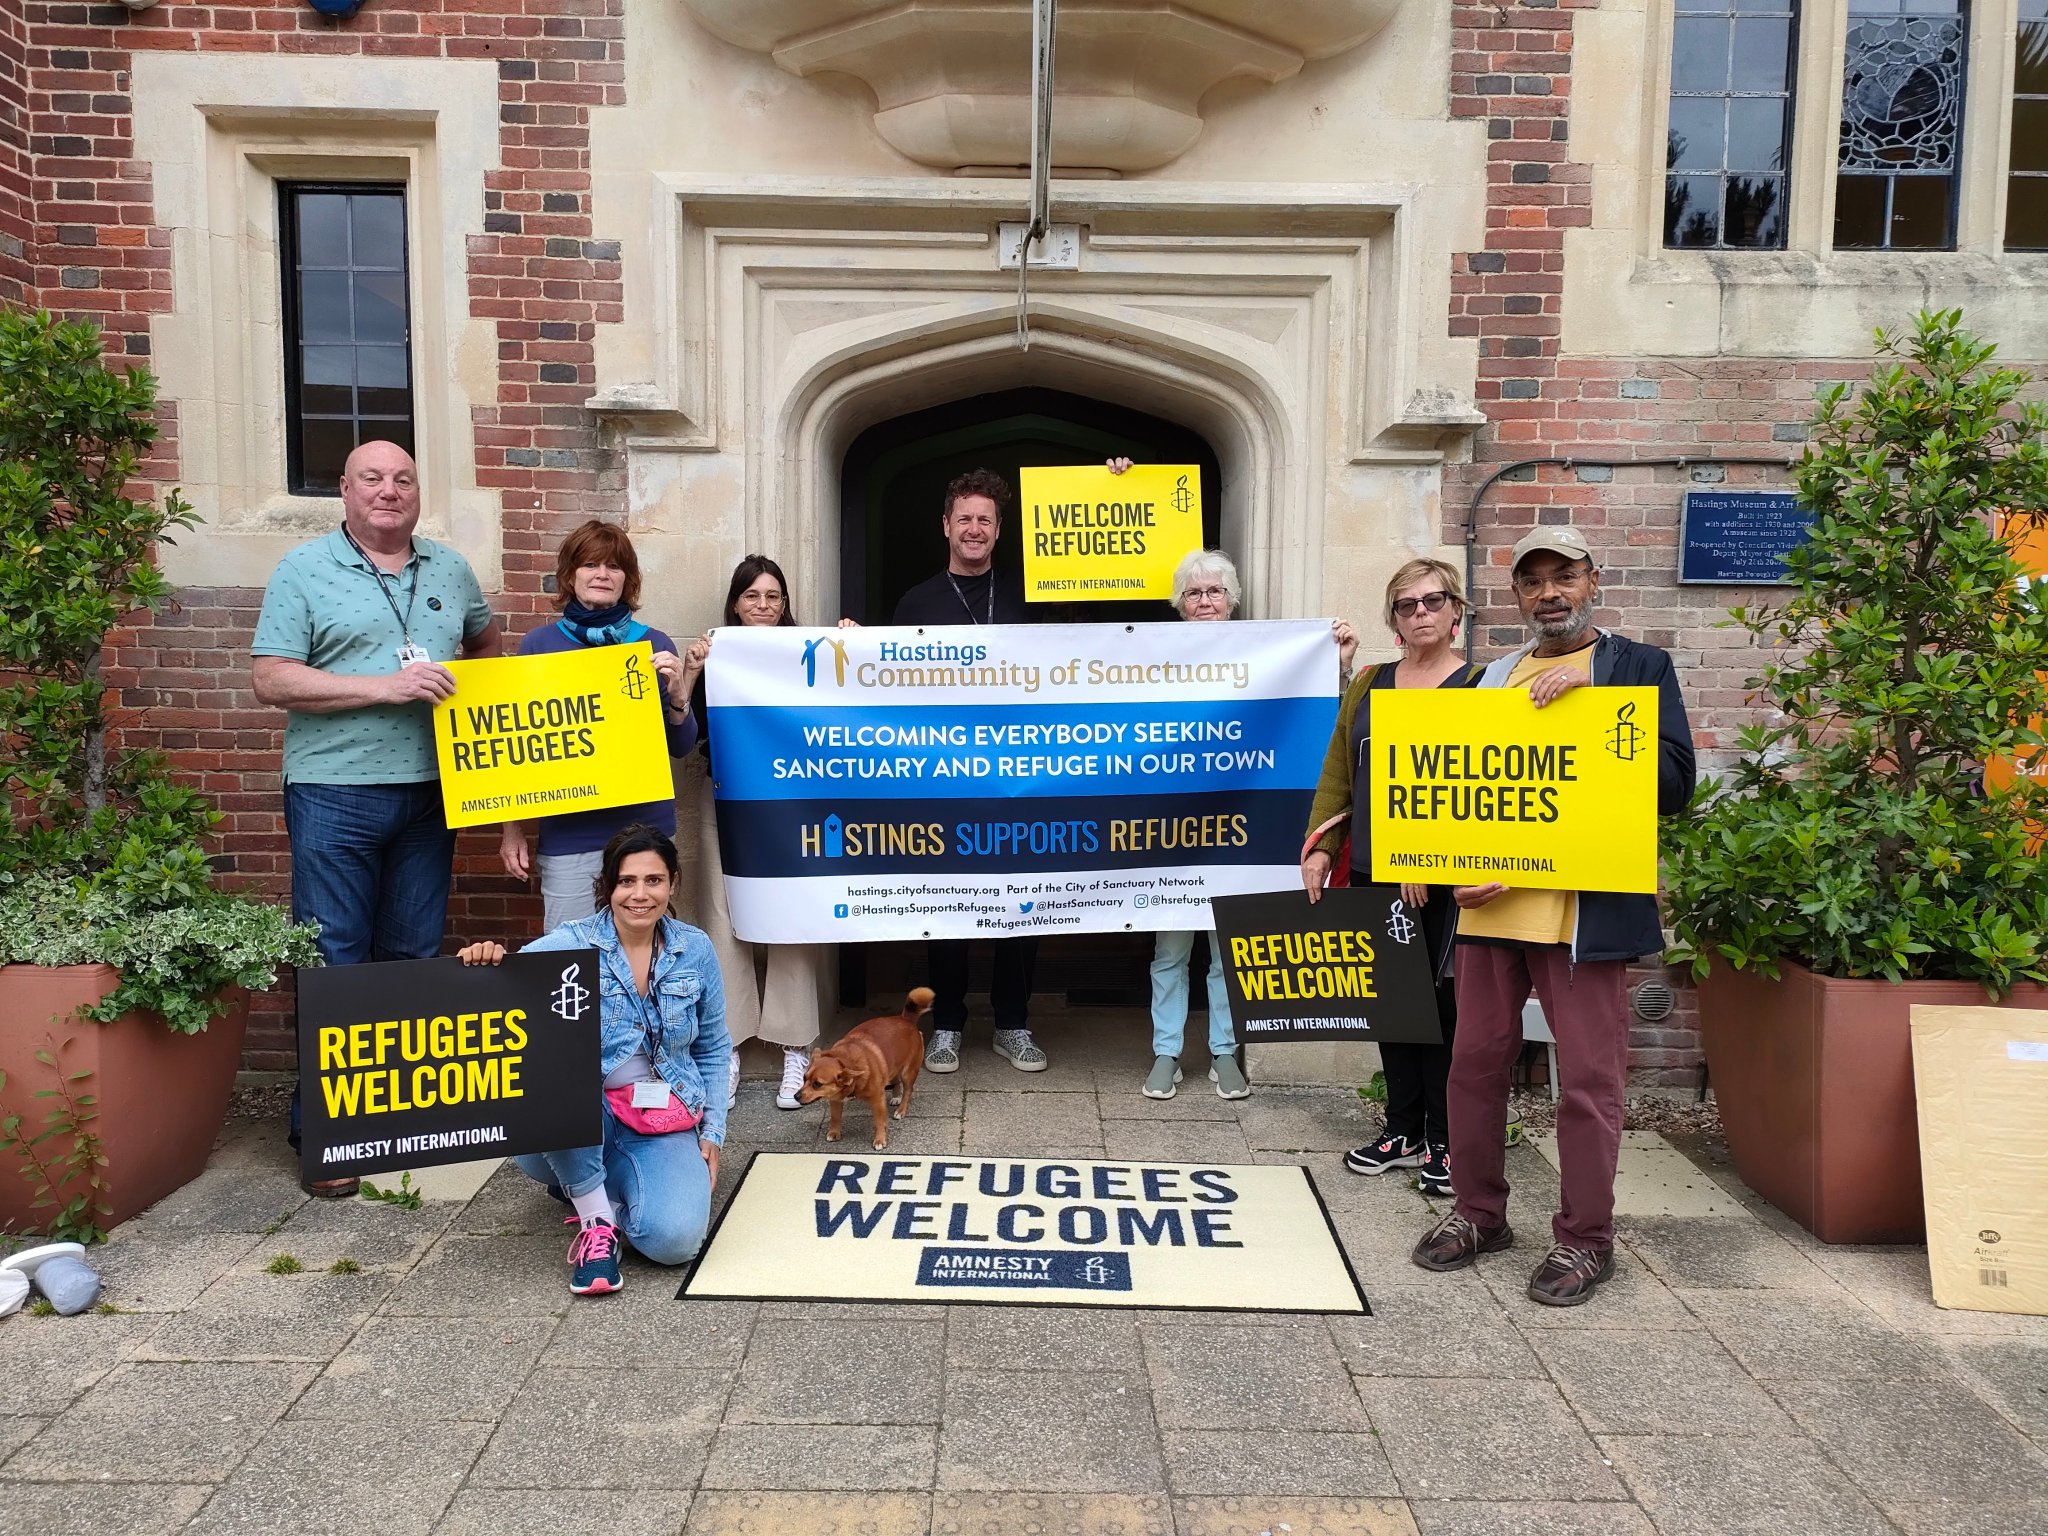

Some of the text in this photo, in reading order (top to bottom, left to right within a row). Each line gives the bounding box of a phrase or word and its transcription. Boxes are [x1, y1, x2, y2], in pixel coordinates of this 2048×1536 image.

[1034, 503, 1156, 529] I WELCOME
[1691, 500, 1728, 510] Hastings
[1730, 500, 1767, 508] Museum
[1769, 500, 1777, 508] &
[1035, 530, 1146, 557] REFUGEES
[1690, 541, 1726, 549] Re-opened
[1728, 542, 1736, 550] by
[1712, 550, 1737, 558] Deputy
[1740, 550, 1762, 558] Mayor
[1717, 570, 1744, 578] Hastings
[1732, 558, 1747, 566] July
[1037, 578, 1146, 591] AMNESTY INTERNATIONAL
[879, 640, 987, 666] Hastings
[857, 658, 1249, 693] Community of Sanctuary
[449, 693, 605, 738] I WELCOME
[802, 720, 1242, 747] WELCOMING EVERYBODY SEEKING
[452, 728, 595, 772] REFUGEES
[1388, 744, 1578, 782] I WELCOME
[772, 750, 1274, 779] SANCTUARY AND REFUGE IN OUR TOWN
[461, 784, 600, 813] AMNESTY INTERNATIONAL
[1388, 784, 1559, 824] REFUGEES
[801, 813, 1248, 858] HSTINGS SUPPORTS REFUGEES
[1390, 852, 1557, 873] AMNESTY INTERNATIONAL
[847, 876, 1205, 898] hastings.cityofsanctuary.org Part of the City of Sanctuary Network
[851, 902, 1006, 916] @HastingsSupportsRefugees
[1036, 898, 1124, 912] @HastSanctuary
[976, 915, 1081, 930] #RefugeesWelcome
[1230, 930, 1375, 968] REFUGEES
[1236, 966, 1378, 1001] WELCOME
[1246, 1017, 1370, 1032] AMNESTY INTERNATIONAL
[318, 1008, 528, 1071] REFUGEES
[320, 1055, 524, 1119] WELCOME
[322, 1125, 508, 1164] AMNESTY INTERNATIONAL
[815, 1160, 1240, 1204] REFUGEES
[814, 1198, 1245, 1248] WELCOME
[932, 1269, 1053, 1281] INTERNATIONAL
[934, 1255, 1054, 1271] AMNESTY
